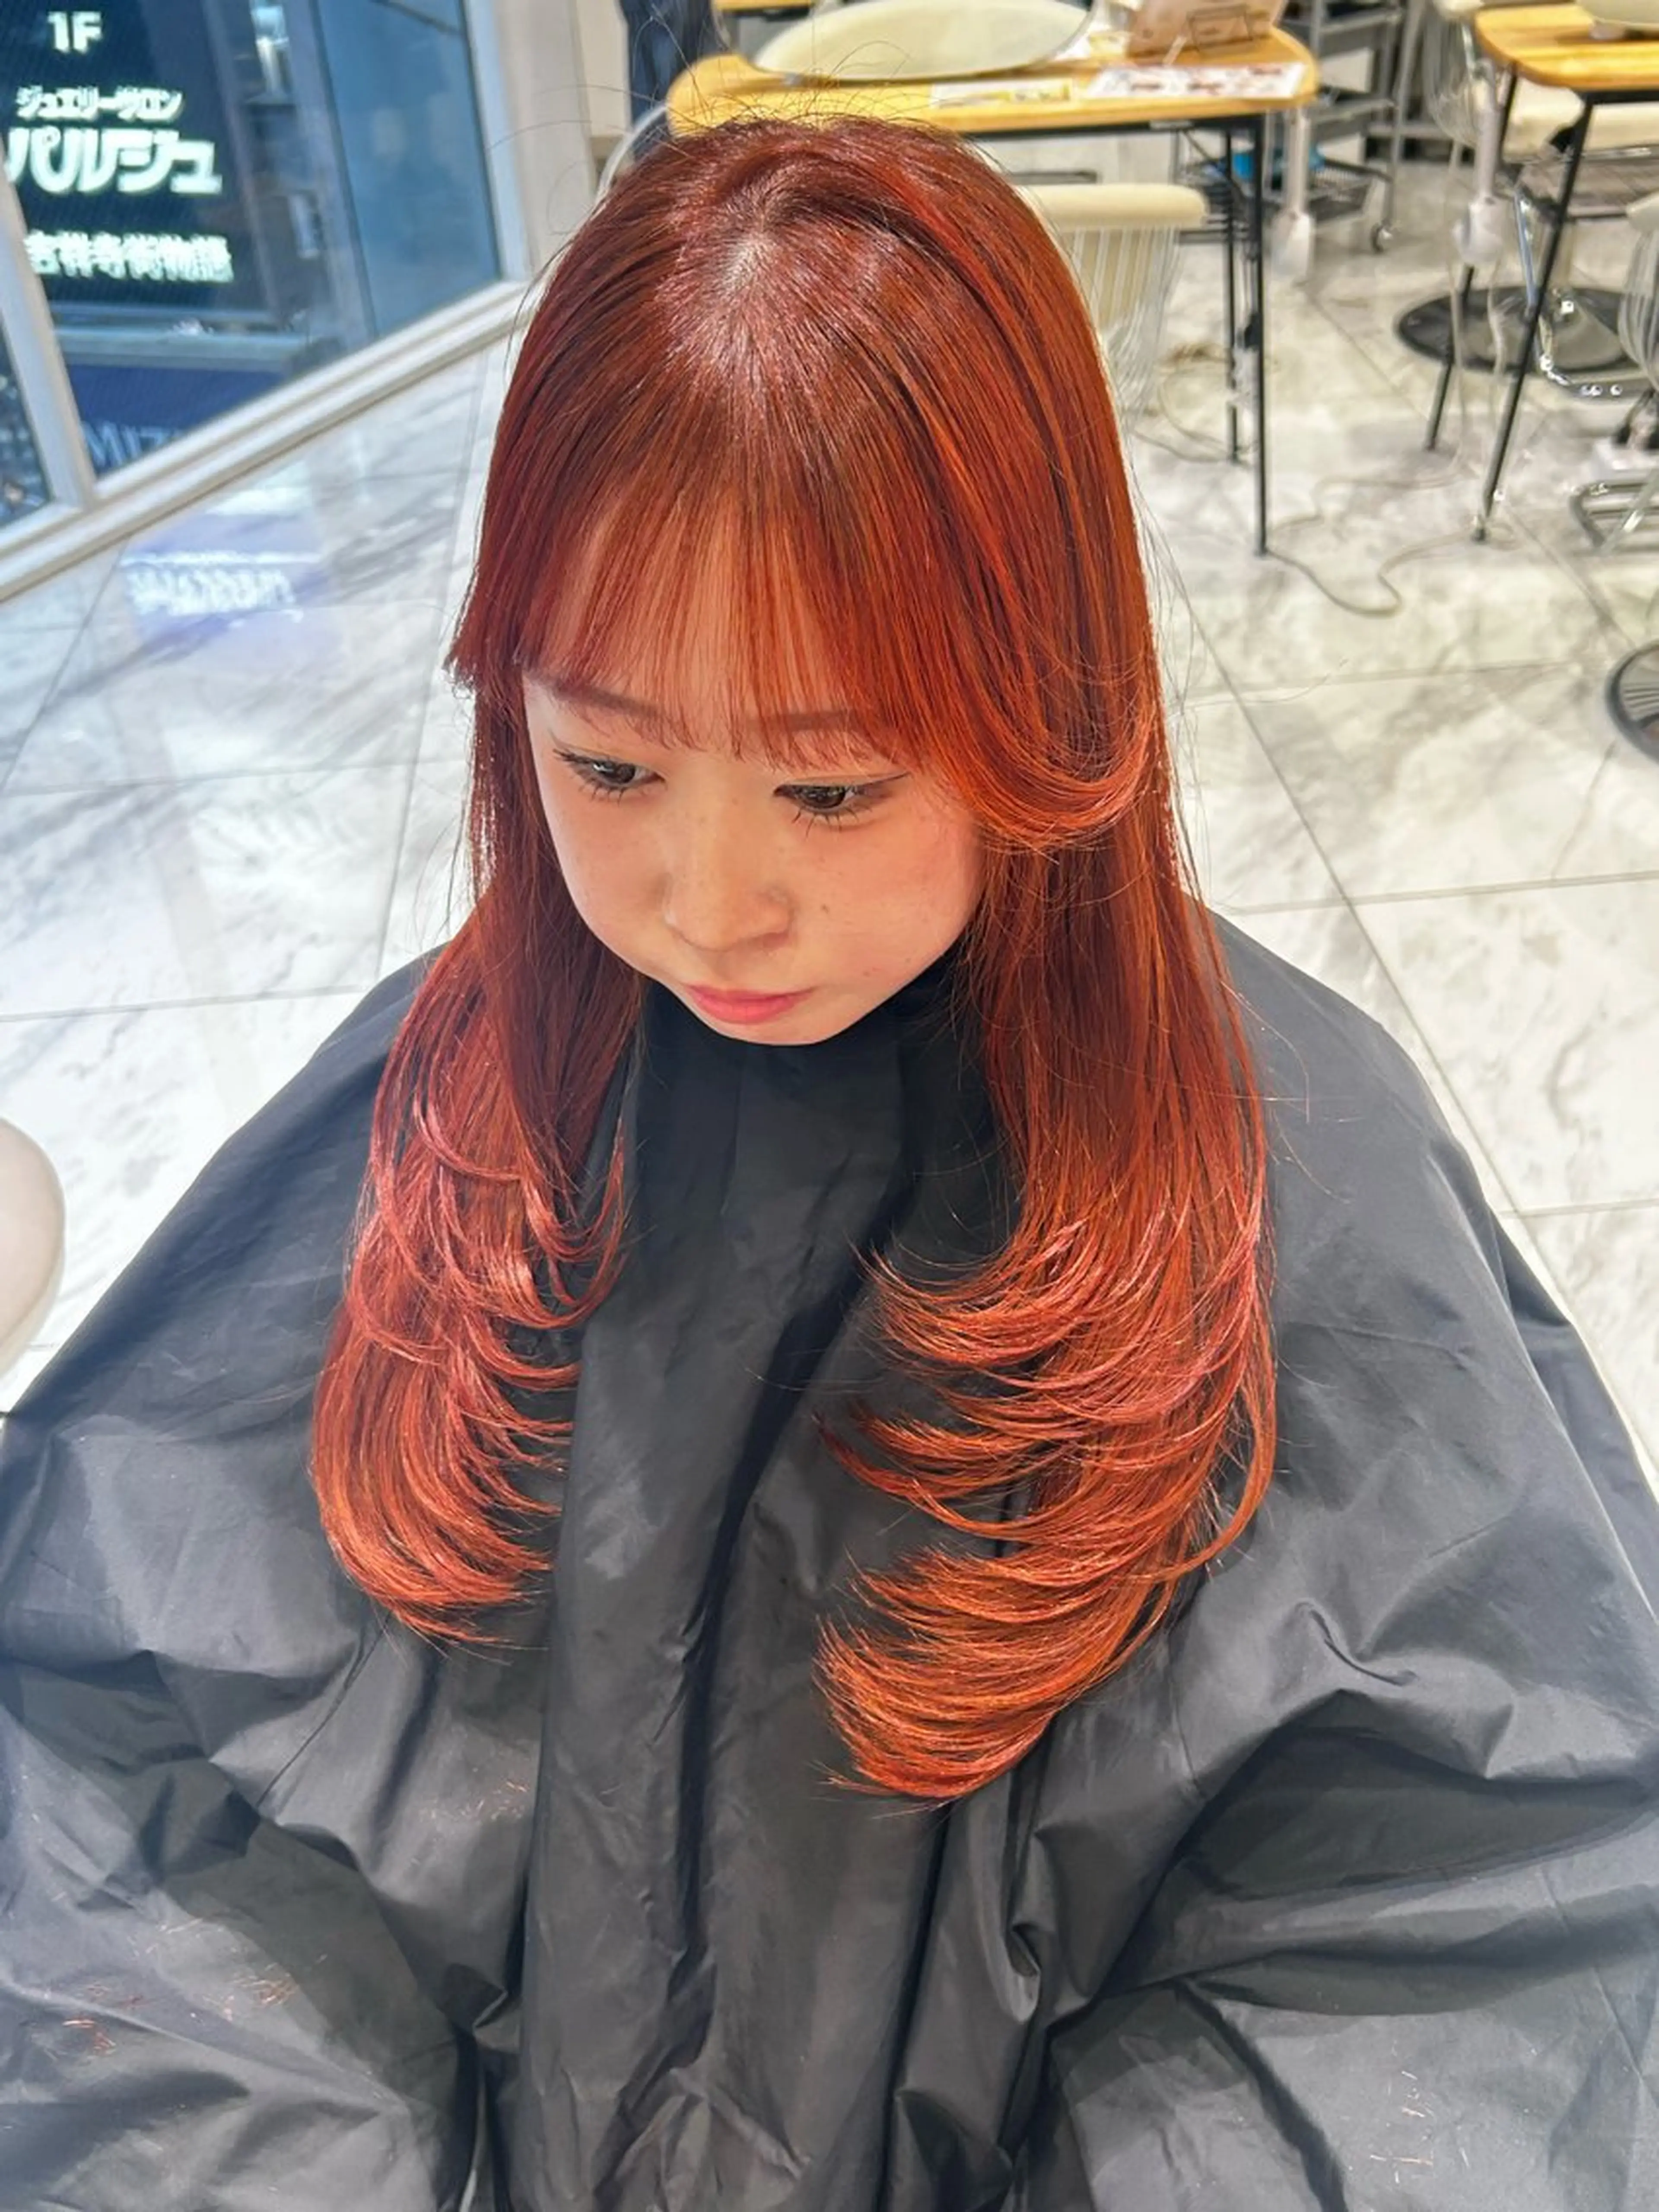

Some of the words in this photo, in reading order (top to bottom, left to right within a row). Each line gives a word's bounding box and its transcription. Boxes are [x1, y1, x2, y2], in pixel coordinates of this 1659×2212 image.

[48, 11, 102, 53] 1F
[16, 86, 183, 121] ジュエリーサロン
